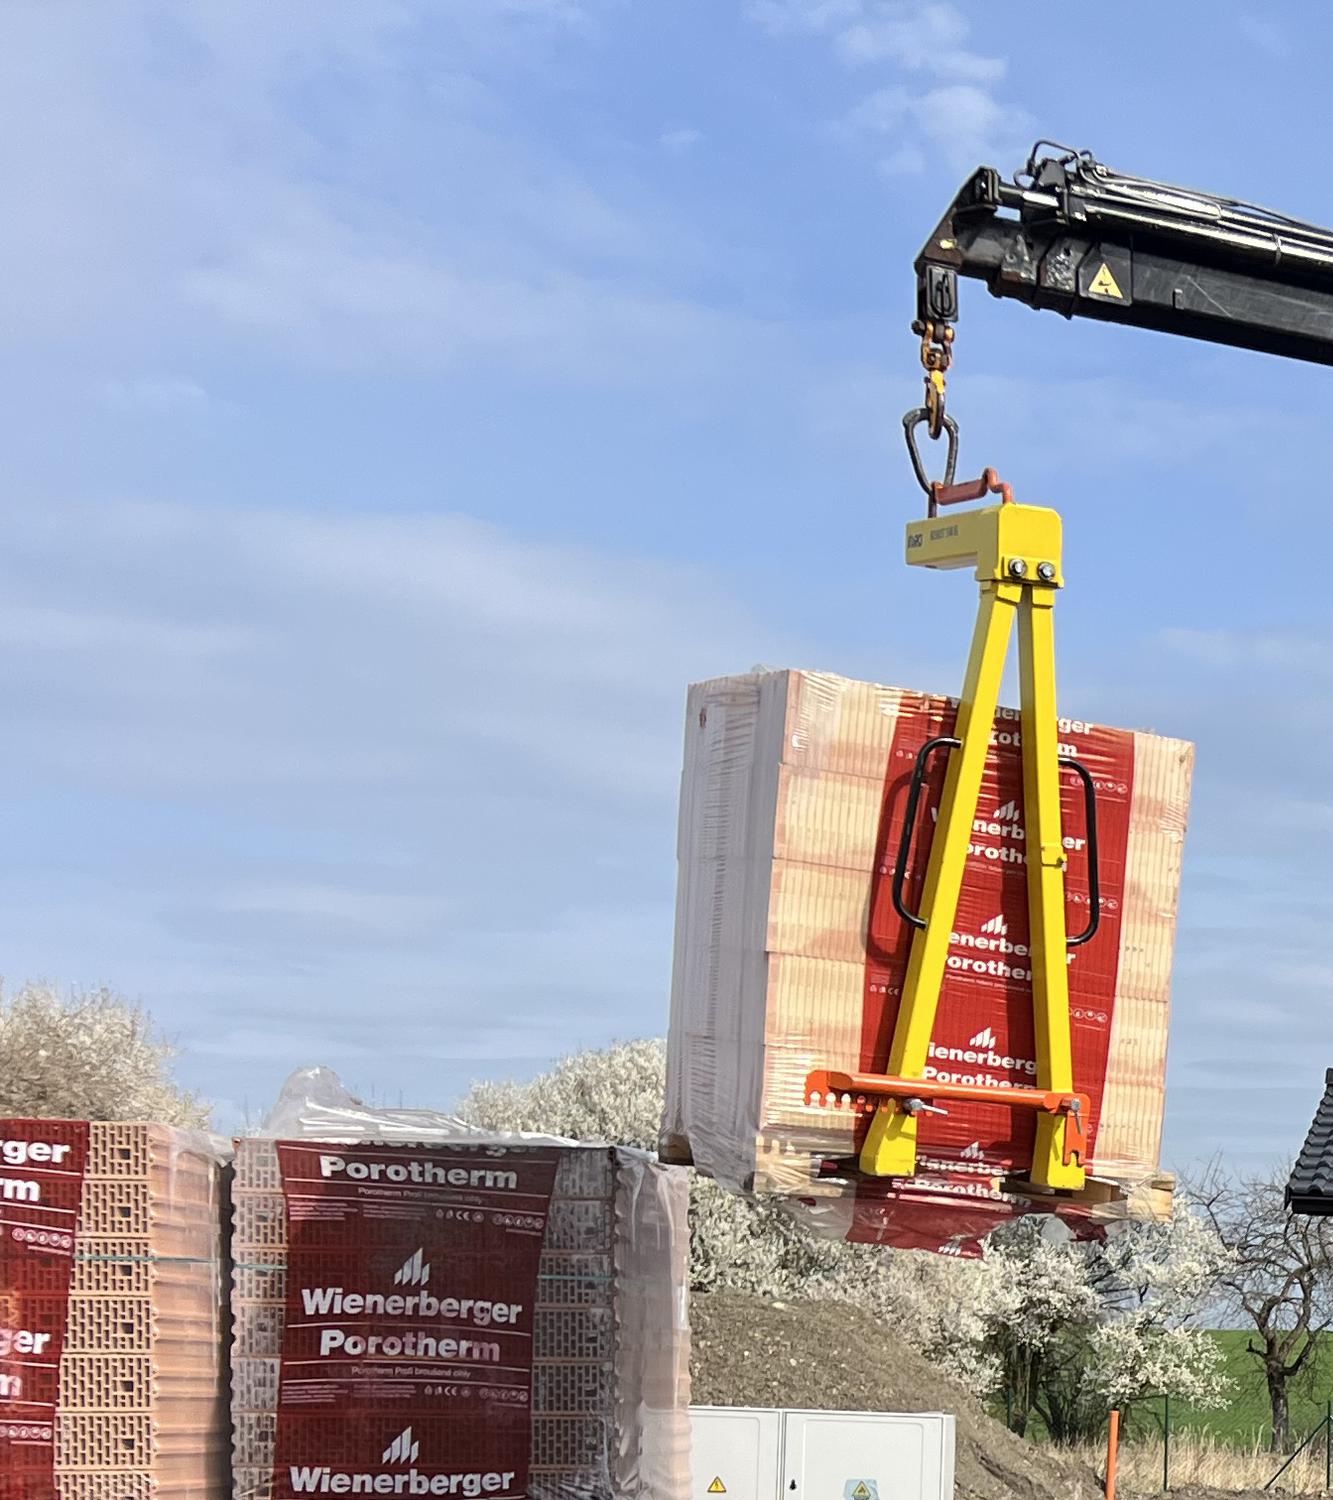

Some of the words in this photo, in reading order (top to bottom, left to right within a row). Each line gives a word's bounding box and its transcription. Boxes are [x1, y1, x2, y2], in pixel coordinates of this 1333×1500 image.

[929, 1042, 1037, 1075] ienerberg
[318, 1155, 517, 1189] Porotherm
[301, 1288, 523, 1326] Wienerberger
[319, 1329, 500, 1362] Porotherm
[289, 1465, 515, 1497] Wienerberger
